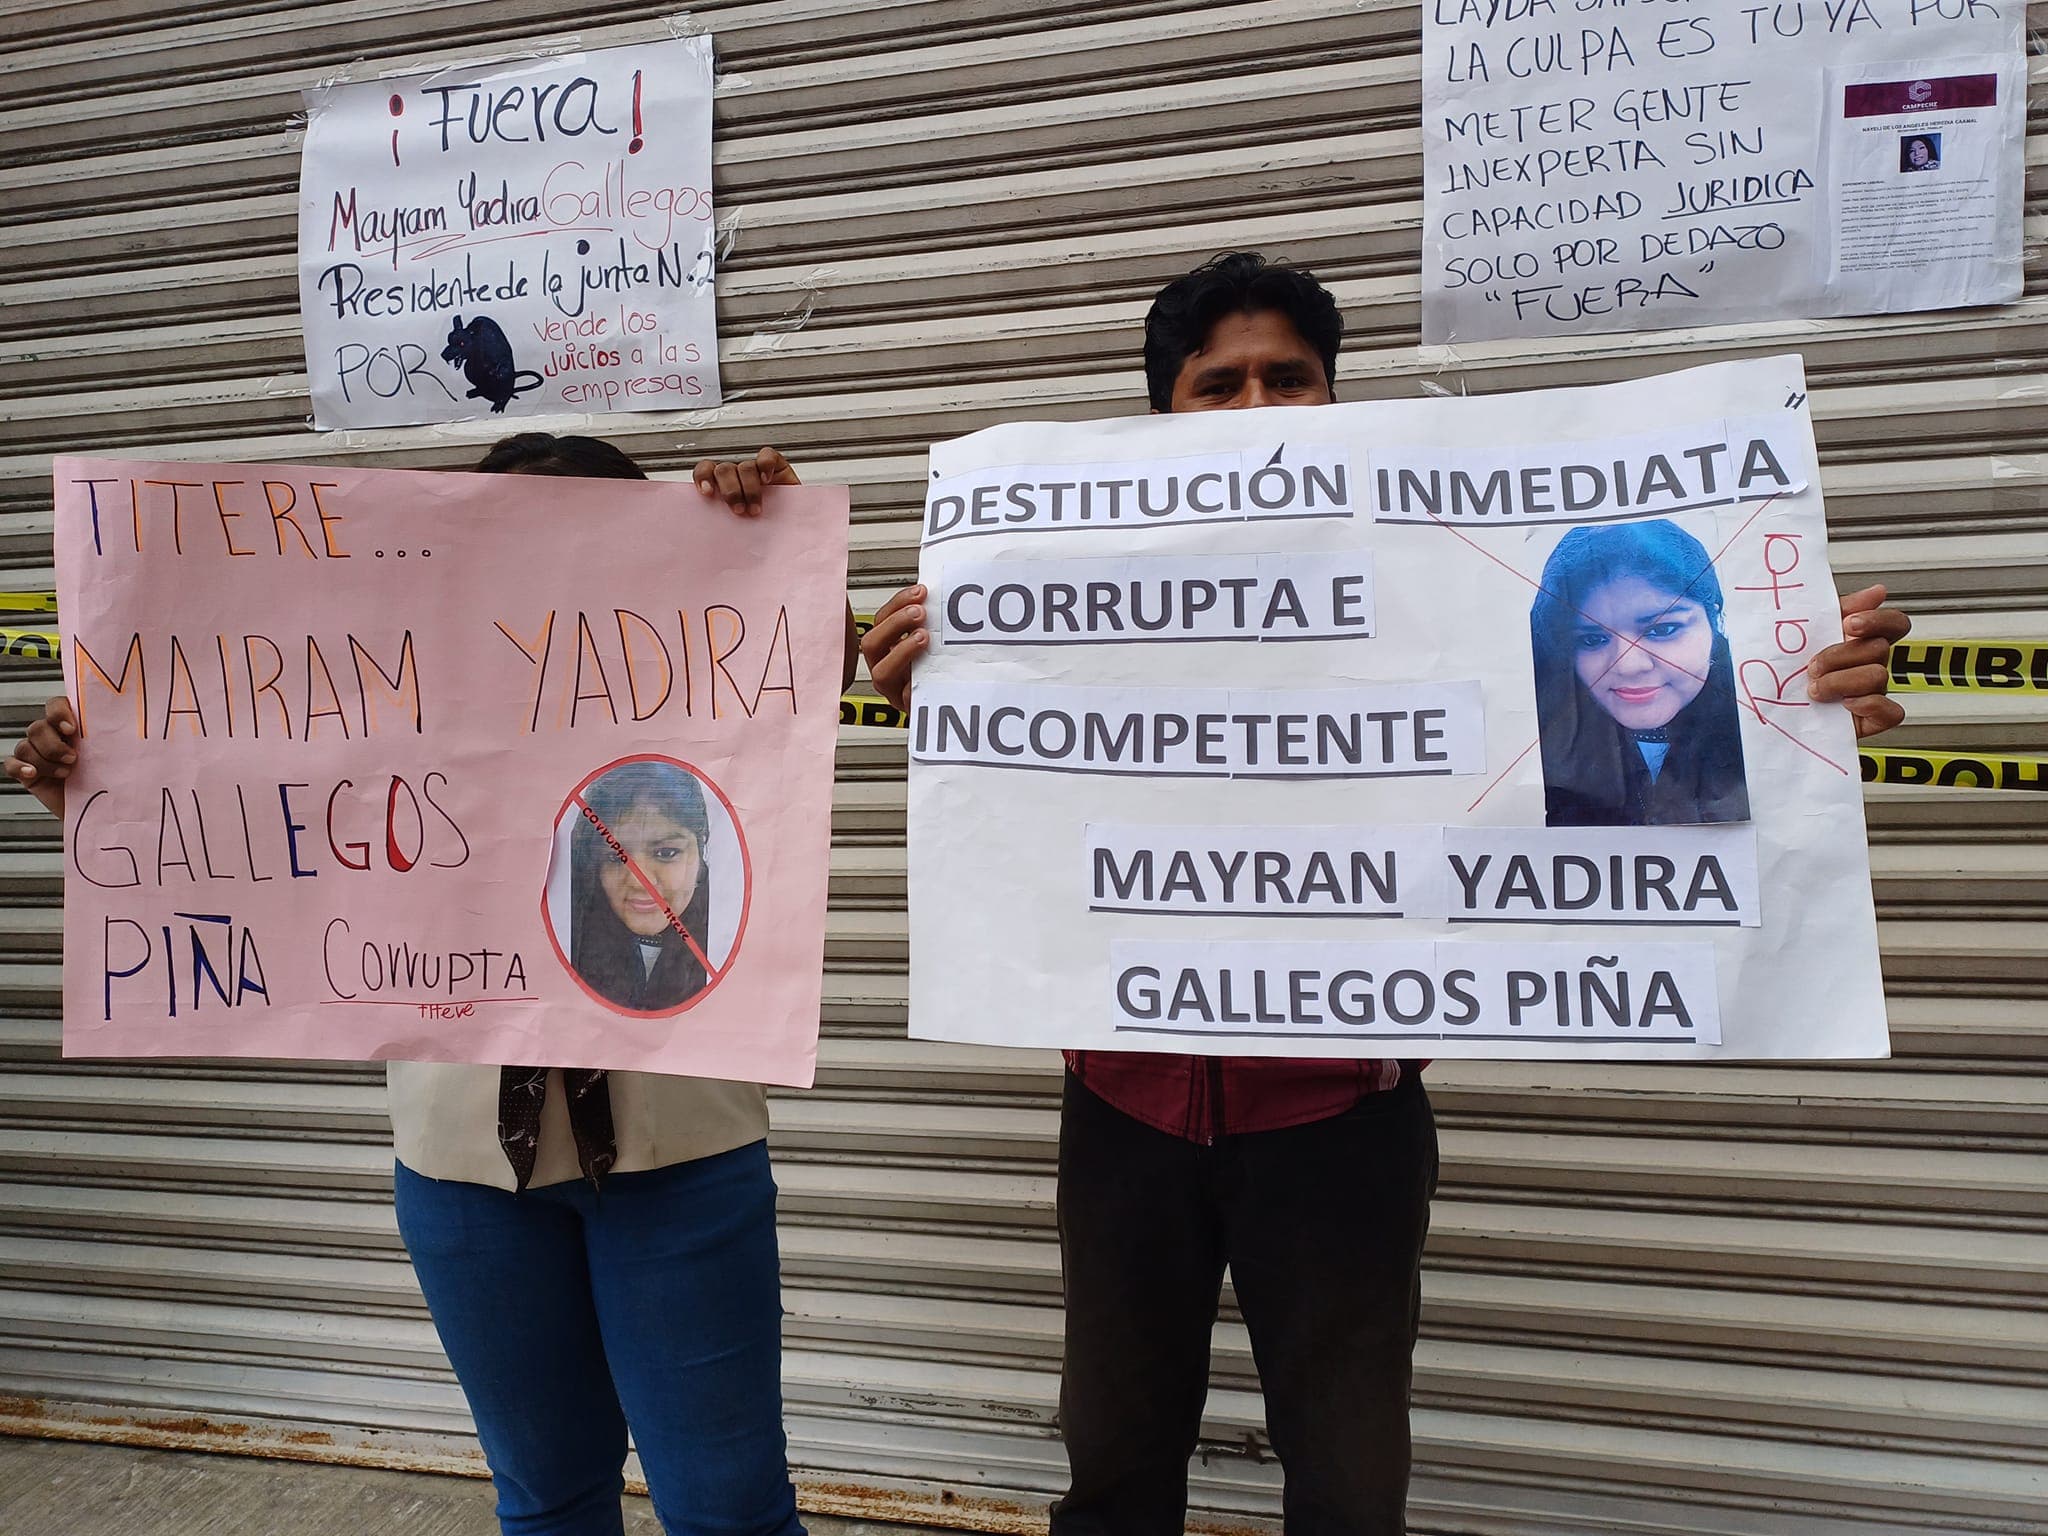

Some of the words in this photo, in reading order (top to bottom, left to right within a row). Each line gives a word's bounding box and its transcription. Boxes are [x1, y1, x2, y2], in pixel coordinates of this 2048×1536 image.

[1447, 42, 1489, 82] LA
[1506, 26, 1635, 76] CULPA
[1656, 17, 1715, 58] ES
[1445, 98, 1595, 146] METER
[1613, 81, 1751, 131] GENTE
[1441, 139, 1666, 195] INEXPERTA
[1685, 127, 1763, 166] SIN
[328, 187, 447, 271] Mayram
[458, 171, 541, 232] Yadira
[542, 159, 713, 250] Gallegos
[1443, 190, 1642, 240] CAPACIDAD
[1667, 168, 1814, 215] JURIDICA
[318, 252, 492, 320] Presidente
[495, 260, 528, 301] de
[543, 250, 564, 298] la
[554, 237, 650, 318] junta
[1445, 252, 1539, 288] SOLO
[1553, 239, 1620, 274] POR
[620, 303, 657, 335] los
[631, 348, 643, 365] a
[659, 334, 701, 366] las
[335, 342, 457, 404] POR
[561, 373, 703, 411] empresas
[72, 479, 431, 560] TITERE...
[928, 442, 1348, 536] DESTITUCIÓN
[1376, 438, 1790, 517] INMEDIATA
[947, 578, 1309, 633] CORRUPTA
[1332, 575, 1365, 627] E
[1735, 532, 1810, 725] Rata
[73, 630, 422, 742] MAIRAM
[493, 604, 798, 734] YADIRA
[914, 704, 1447, 766] INCOMPETENTE
[73, 772, 470, 888] GALLEGOS
[1093, 848, 1398, 904] MAYRAN
[1447, 855, 1739, 911] YADIRA
[104, 911, 271, 1020] PIÑA
[1116, 966, 1481, 1026] GALLEGOS
[1506, 956, 1694, 1028] PIÑA
